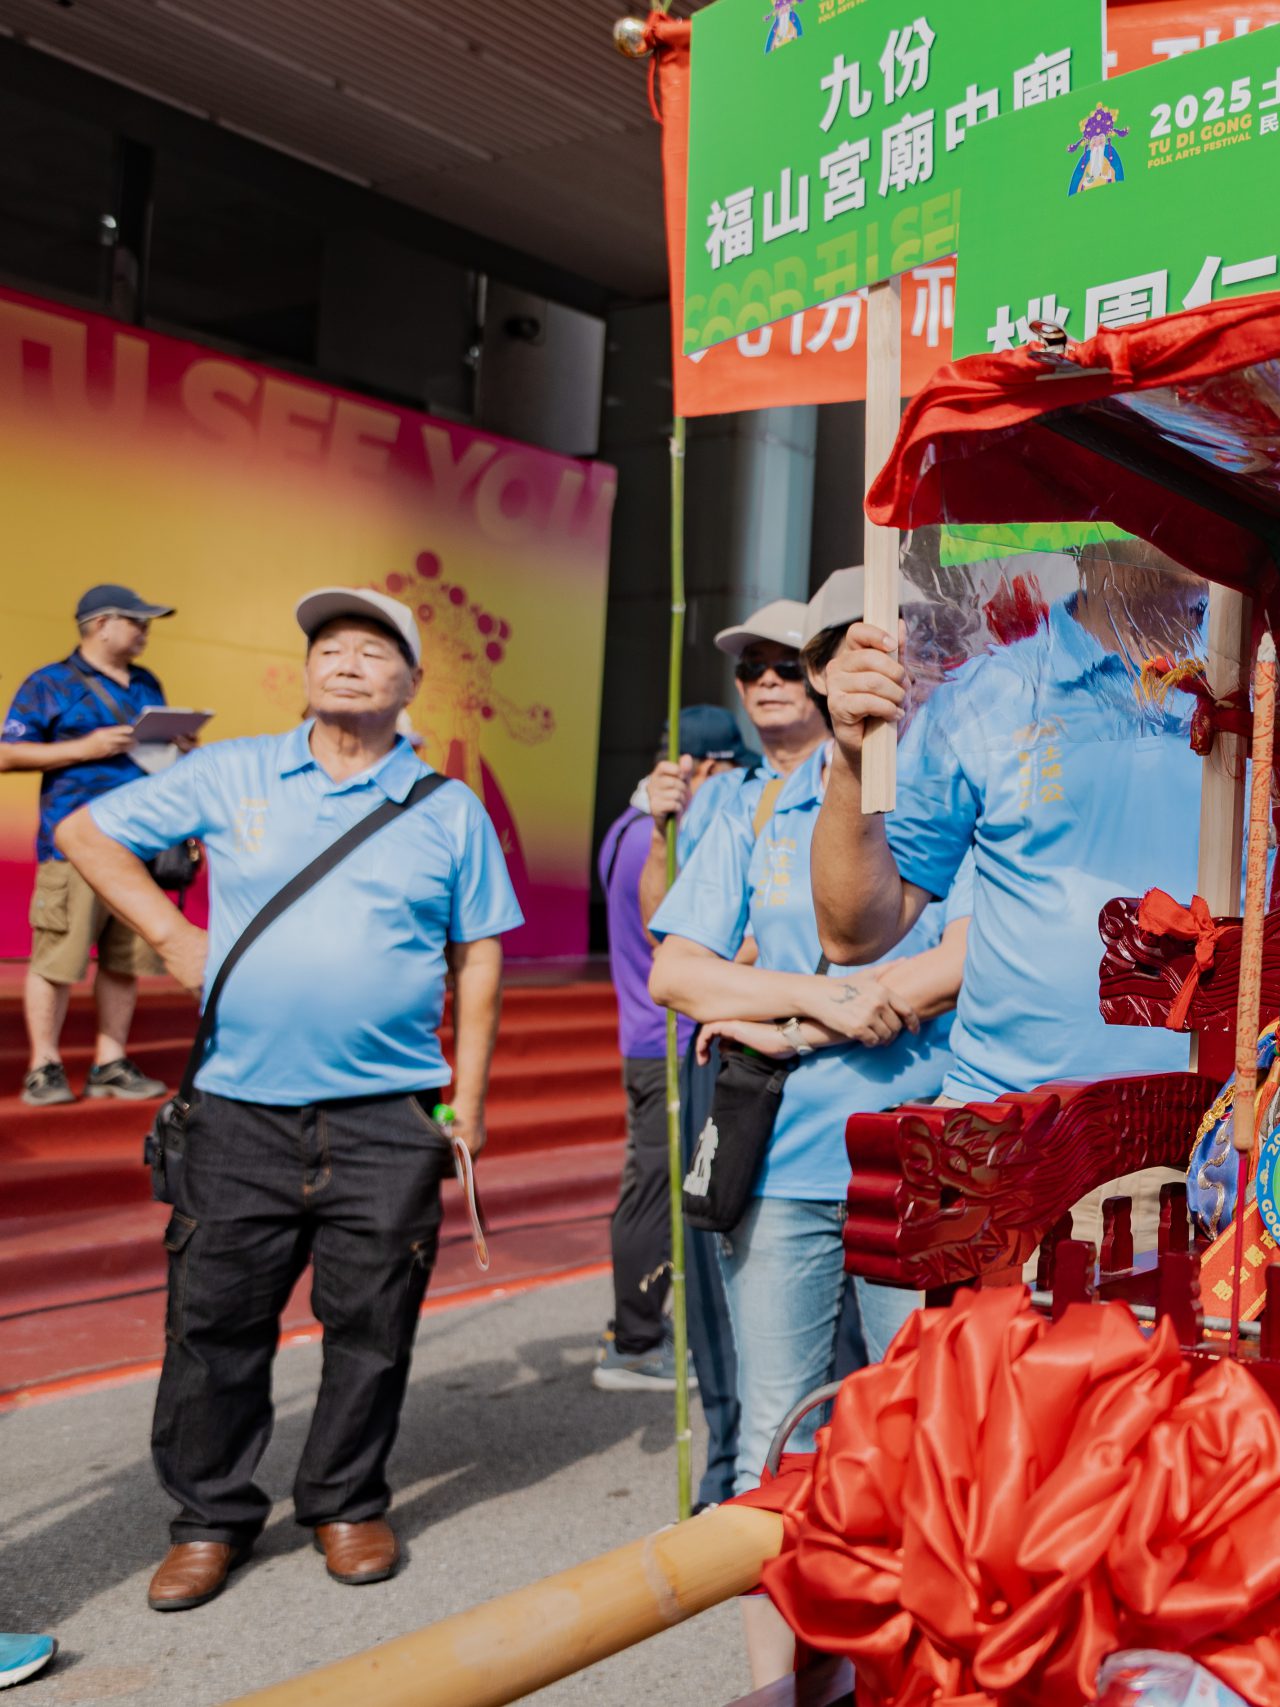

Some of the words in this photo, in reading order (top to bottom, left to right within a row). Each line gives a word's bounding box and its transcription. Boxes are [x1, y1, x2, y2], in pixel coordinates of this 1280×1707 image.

[819, 16, 936, 133] 九份
[705, 47, 1071, 271] 福山宮廟中廟
[1148, 154, 1173, 168] FOLK
[1175, 146, 1201, 160] ARTS
[1204, 132, 1251, 152] FESTIVAL
[1149, 138, 1171, 156] TU
[1176, 131, 1195, 149] DI
[1201, 114, 1252, 141] GONG
